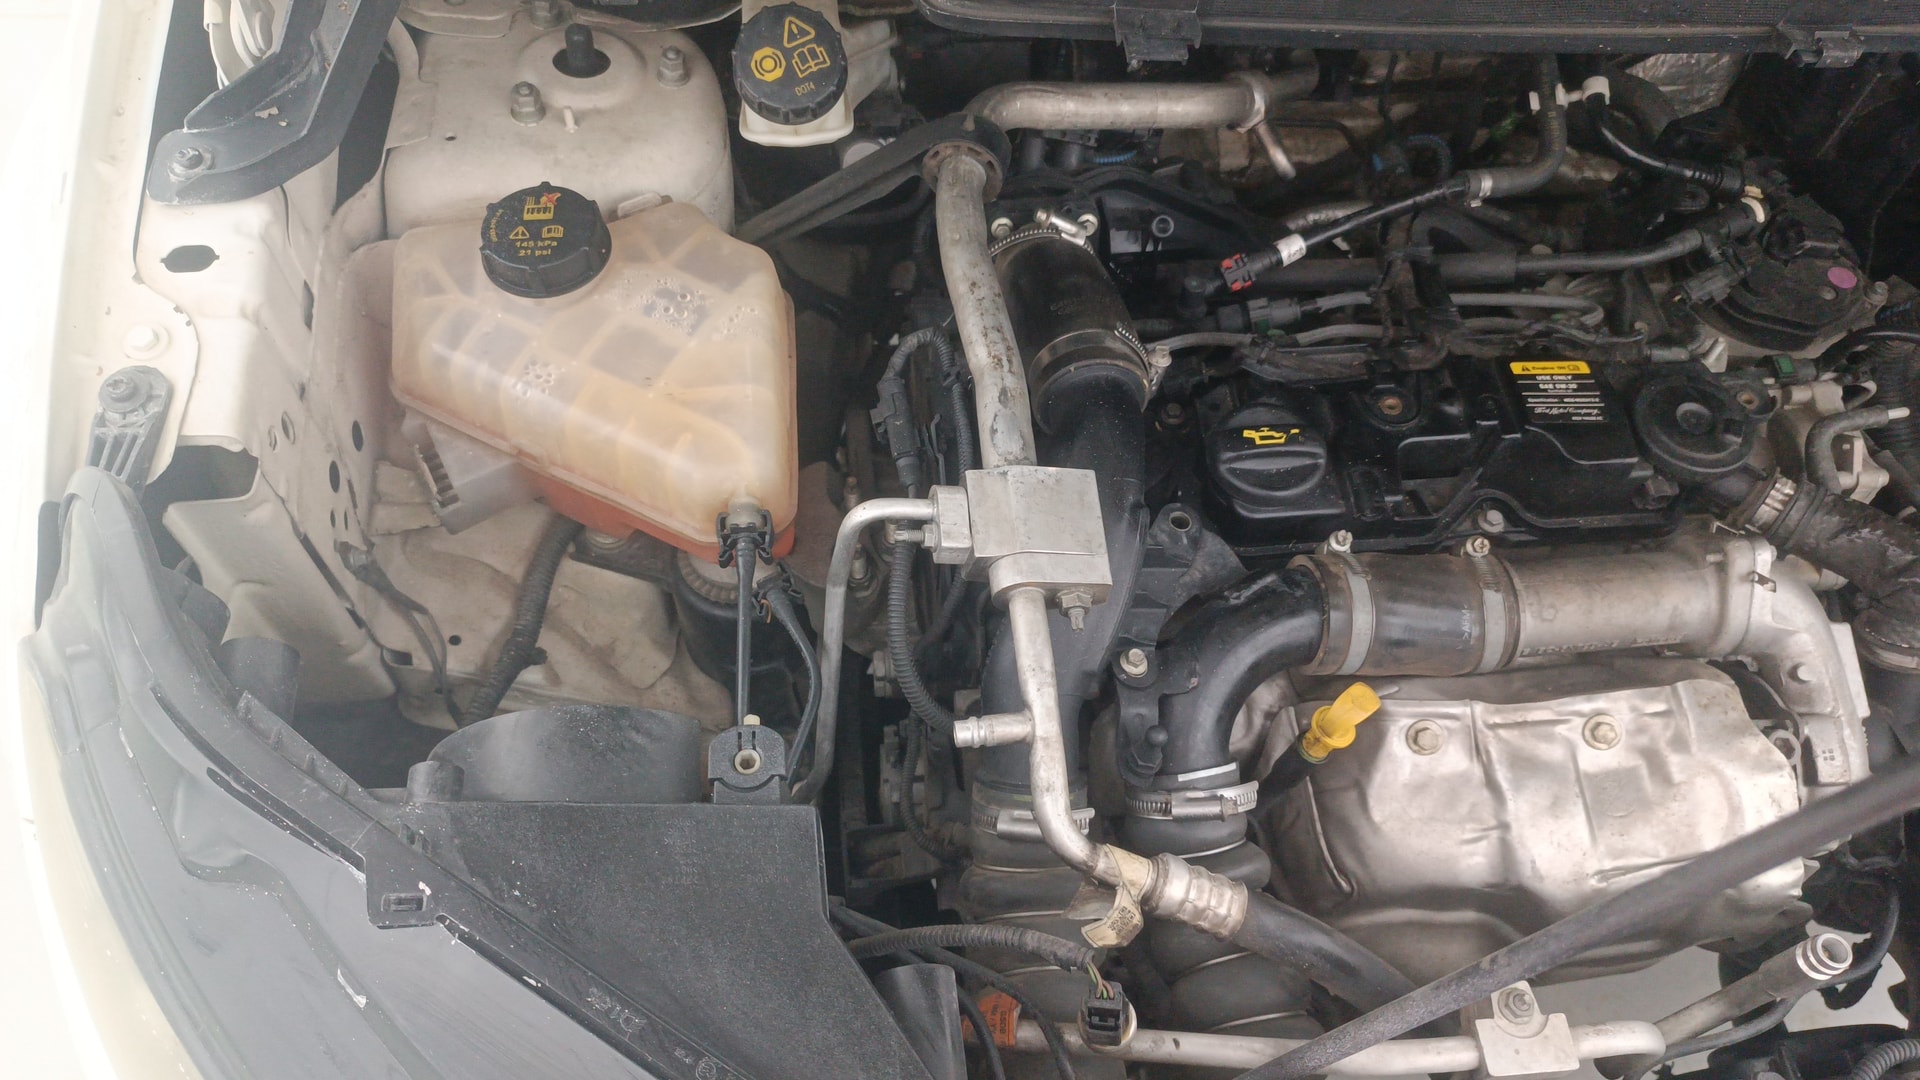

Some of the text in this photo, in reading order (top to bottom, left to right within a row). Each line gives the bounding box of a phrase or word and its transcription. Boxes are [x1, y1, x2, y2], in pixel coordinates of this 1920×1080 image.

[795, 81, 816, 96] DOT4
[515, 240, 535, 248] 145
[519, 249, 552, 257] 21 psi
[1534, 406, 1550, 414] Ford
[1550, 406, 1569, 415] Motor
